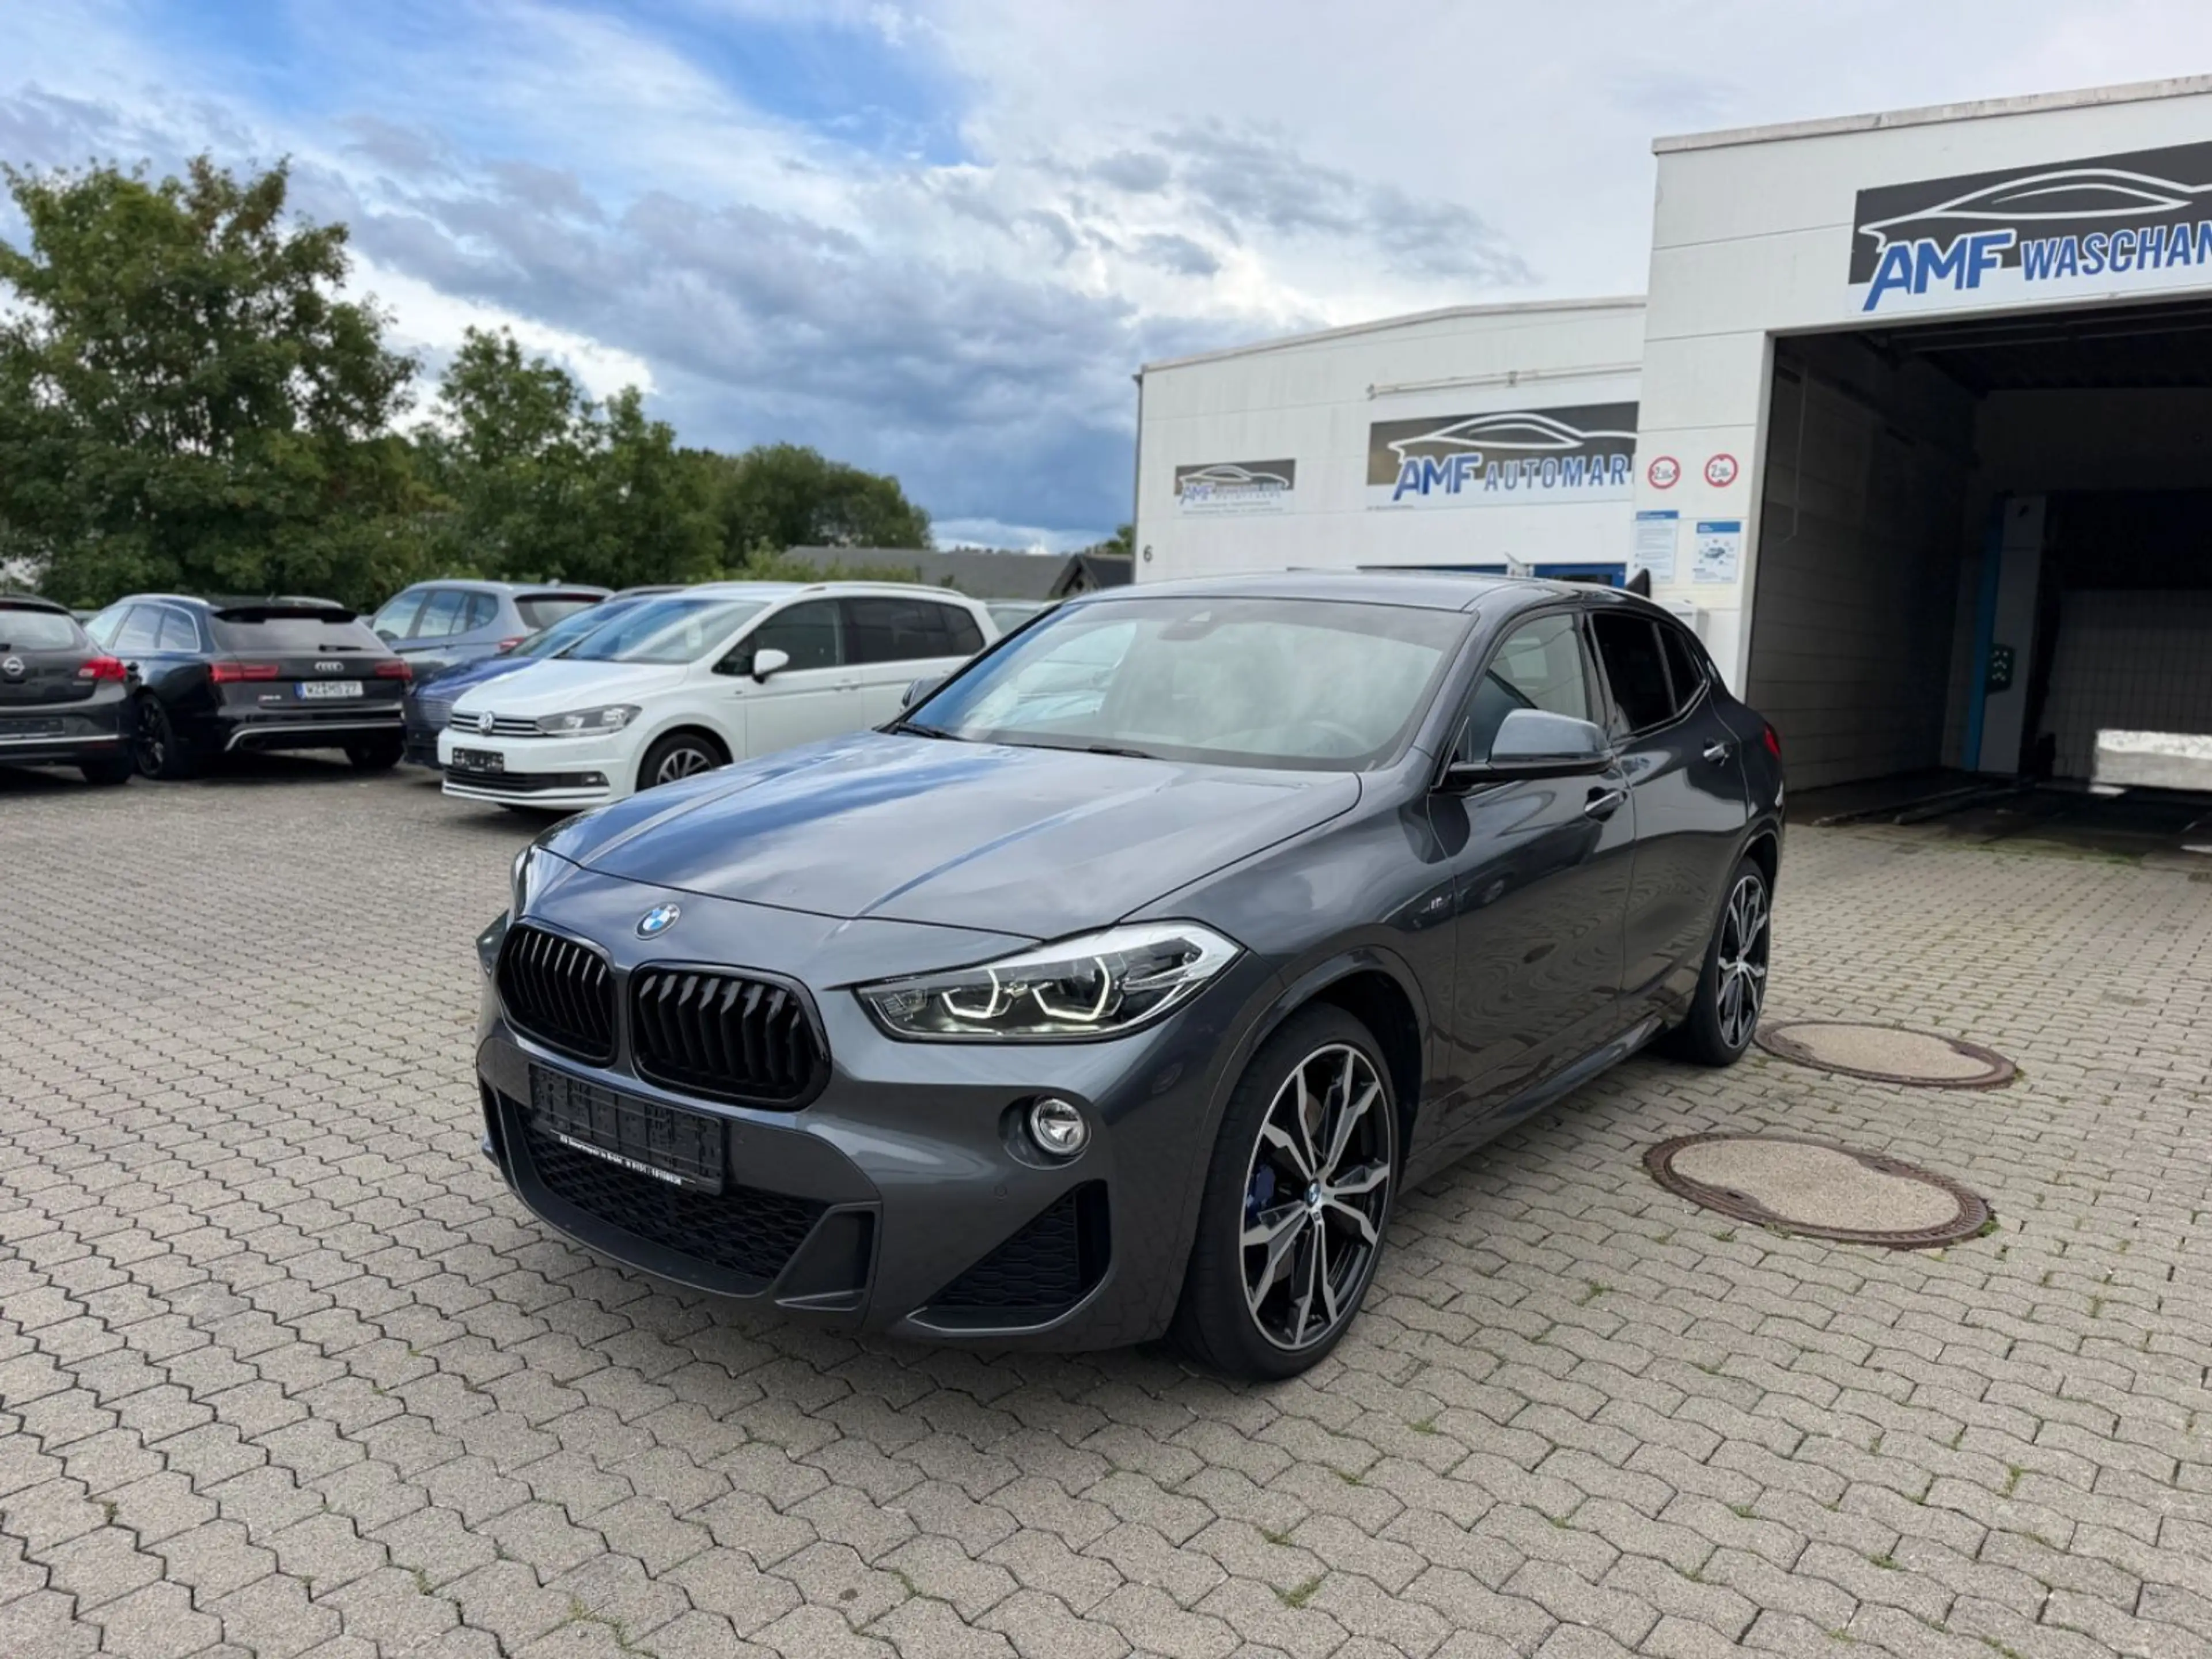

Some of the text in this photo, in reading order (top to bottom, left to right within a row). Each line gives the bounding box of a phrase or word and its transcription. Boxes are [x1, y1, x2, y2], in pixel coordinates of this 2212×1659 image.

[1862, 232, 2013, 312] AMF
[1392, 454, 1635, 501] AMF AUTOMAR
[1143, 545, 1153, 562] 6
